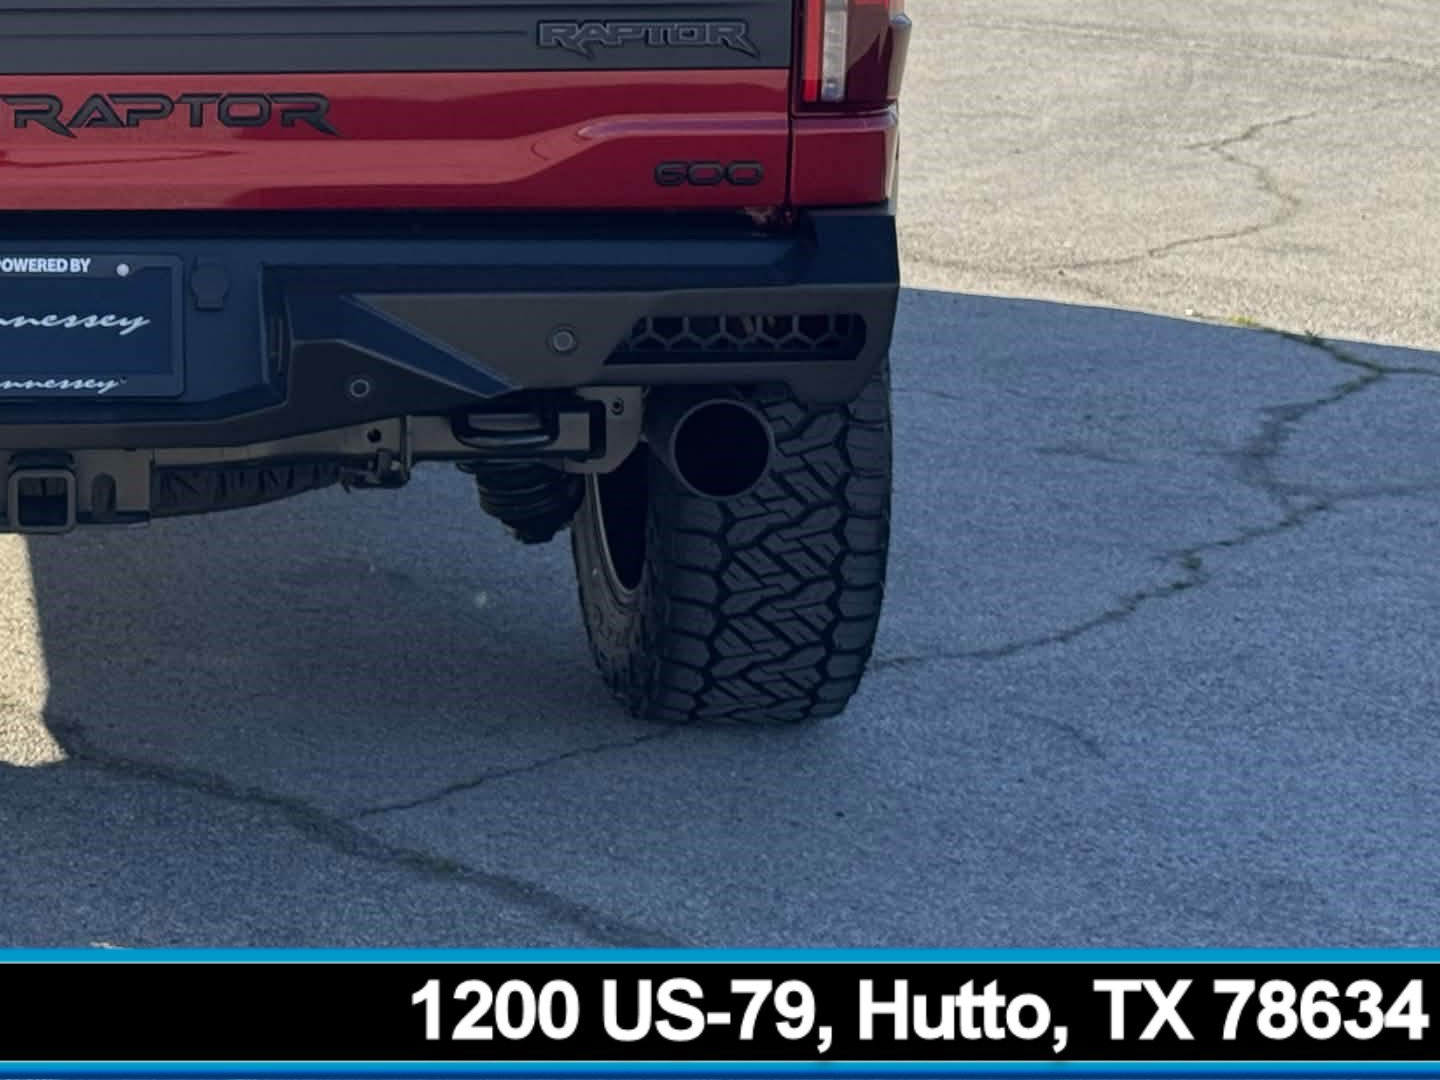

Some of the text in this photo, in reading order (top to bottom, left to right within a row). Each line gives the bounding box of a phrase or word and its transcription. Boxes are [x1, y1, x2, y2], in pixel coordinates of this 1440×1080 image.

[536, 18, 757, 59] RAPTOR
[654, 161, 763, 187] 600
[70, 257, 92, 274] BY
